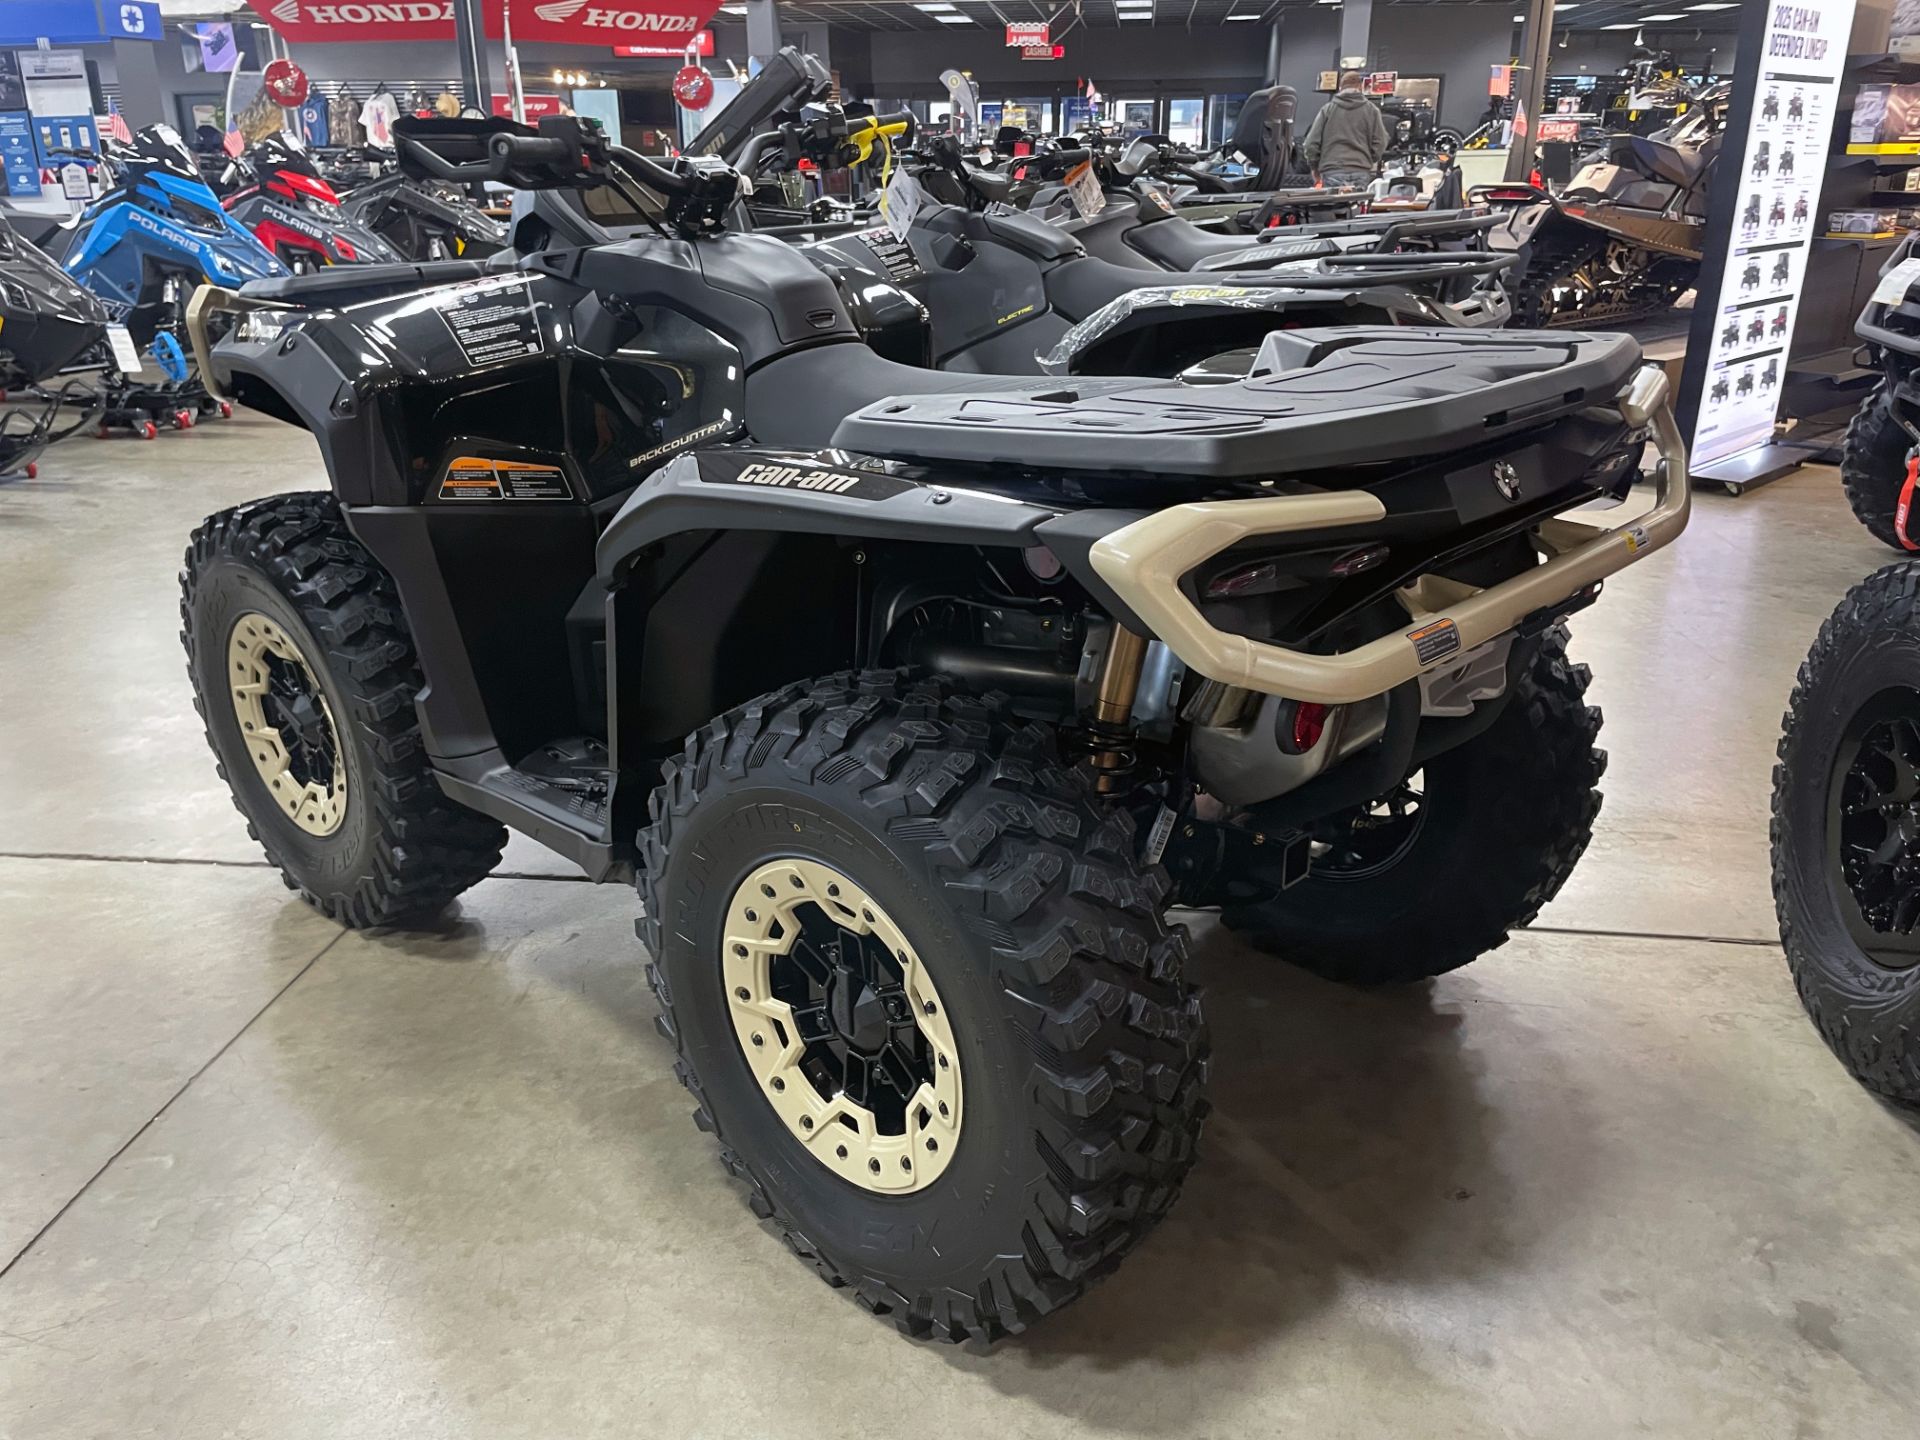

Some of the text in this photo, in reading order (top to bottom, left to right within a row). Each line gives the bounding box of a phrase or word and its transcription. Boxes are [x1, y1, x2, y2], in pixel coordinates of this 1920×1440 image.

[582, 8, 697, 32] HONDA
[1025, 46, 1053, 56] CASHIER
[1769, 33, 1828, 60] DEFENDER LINEUP
[128, 211, 201, 253] POLARIS
[262, 204, 323, 239] POLARIS
[997, 304, 1034, 324] ELECTRIC
[629, 420, 727, 468] BACKCOUNTRY
[737, 463, 860, 493] can-am
